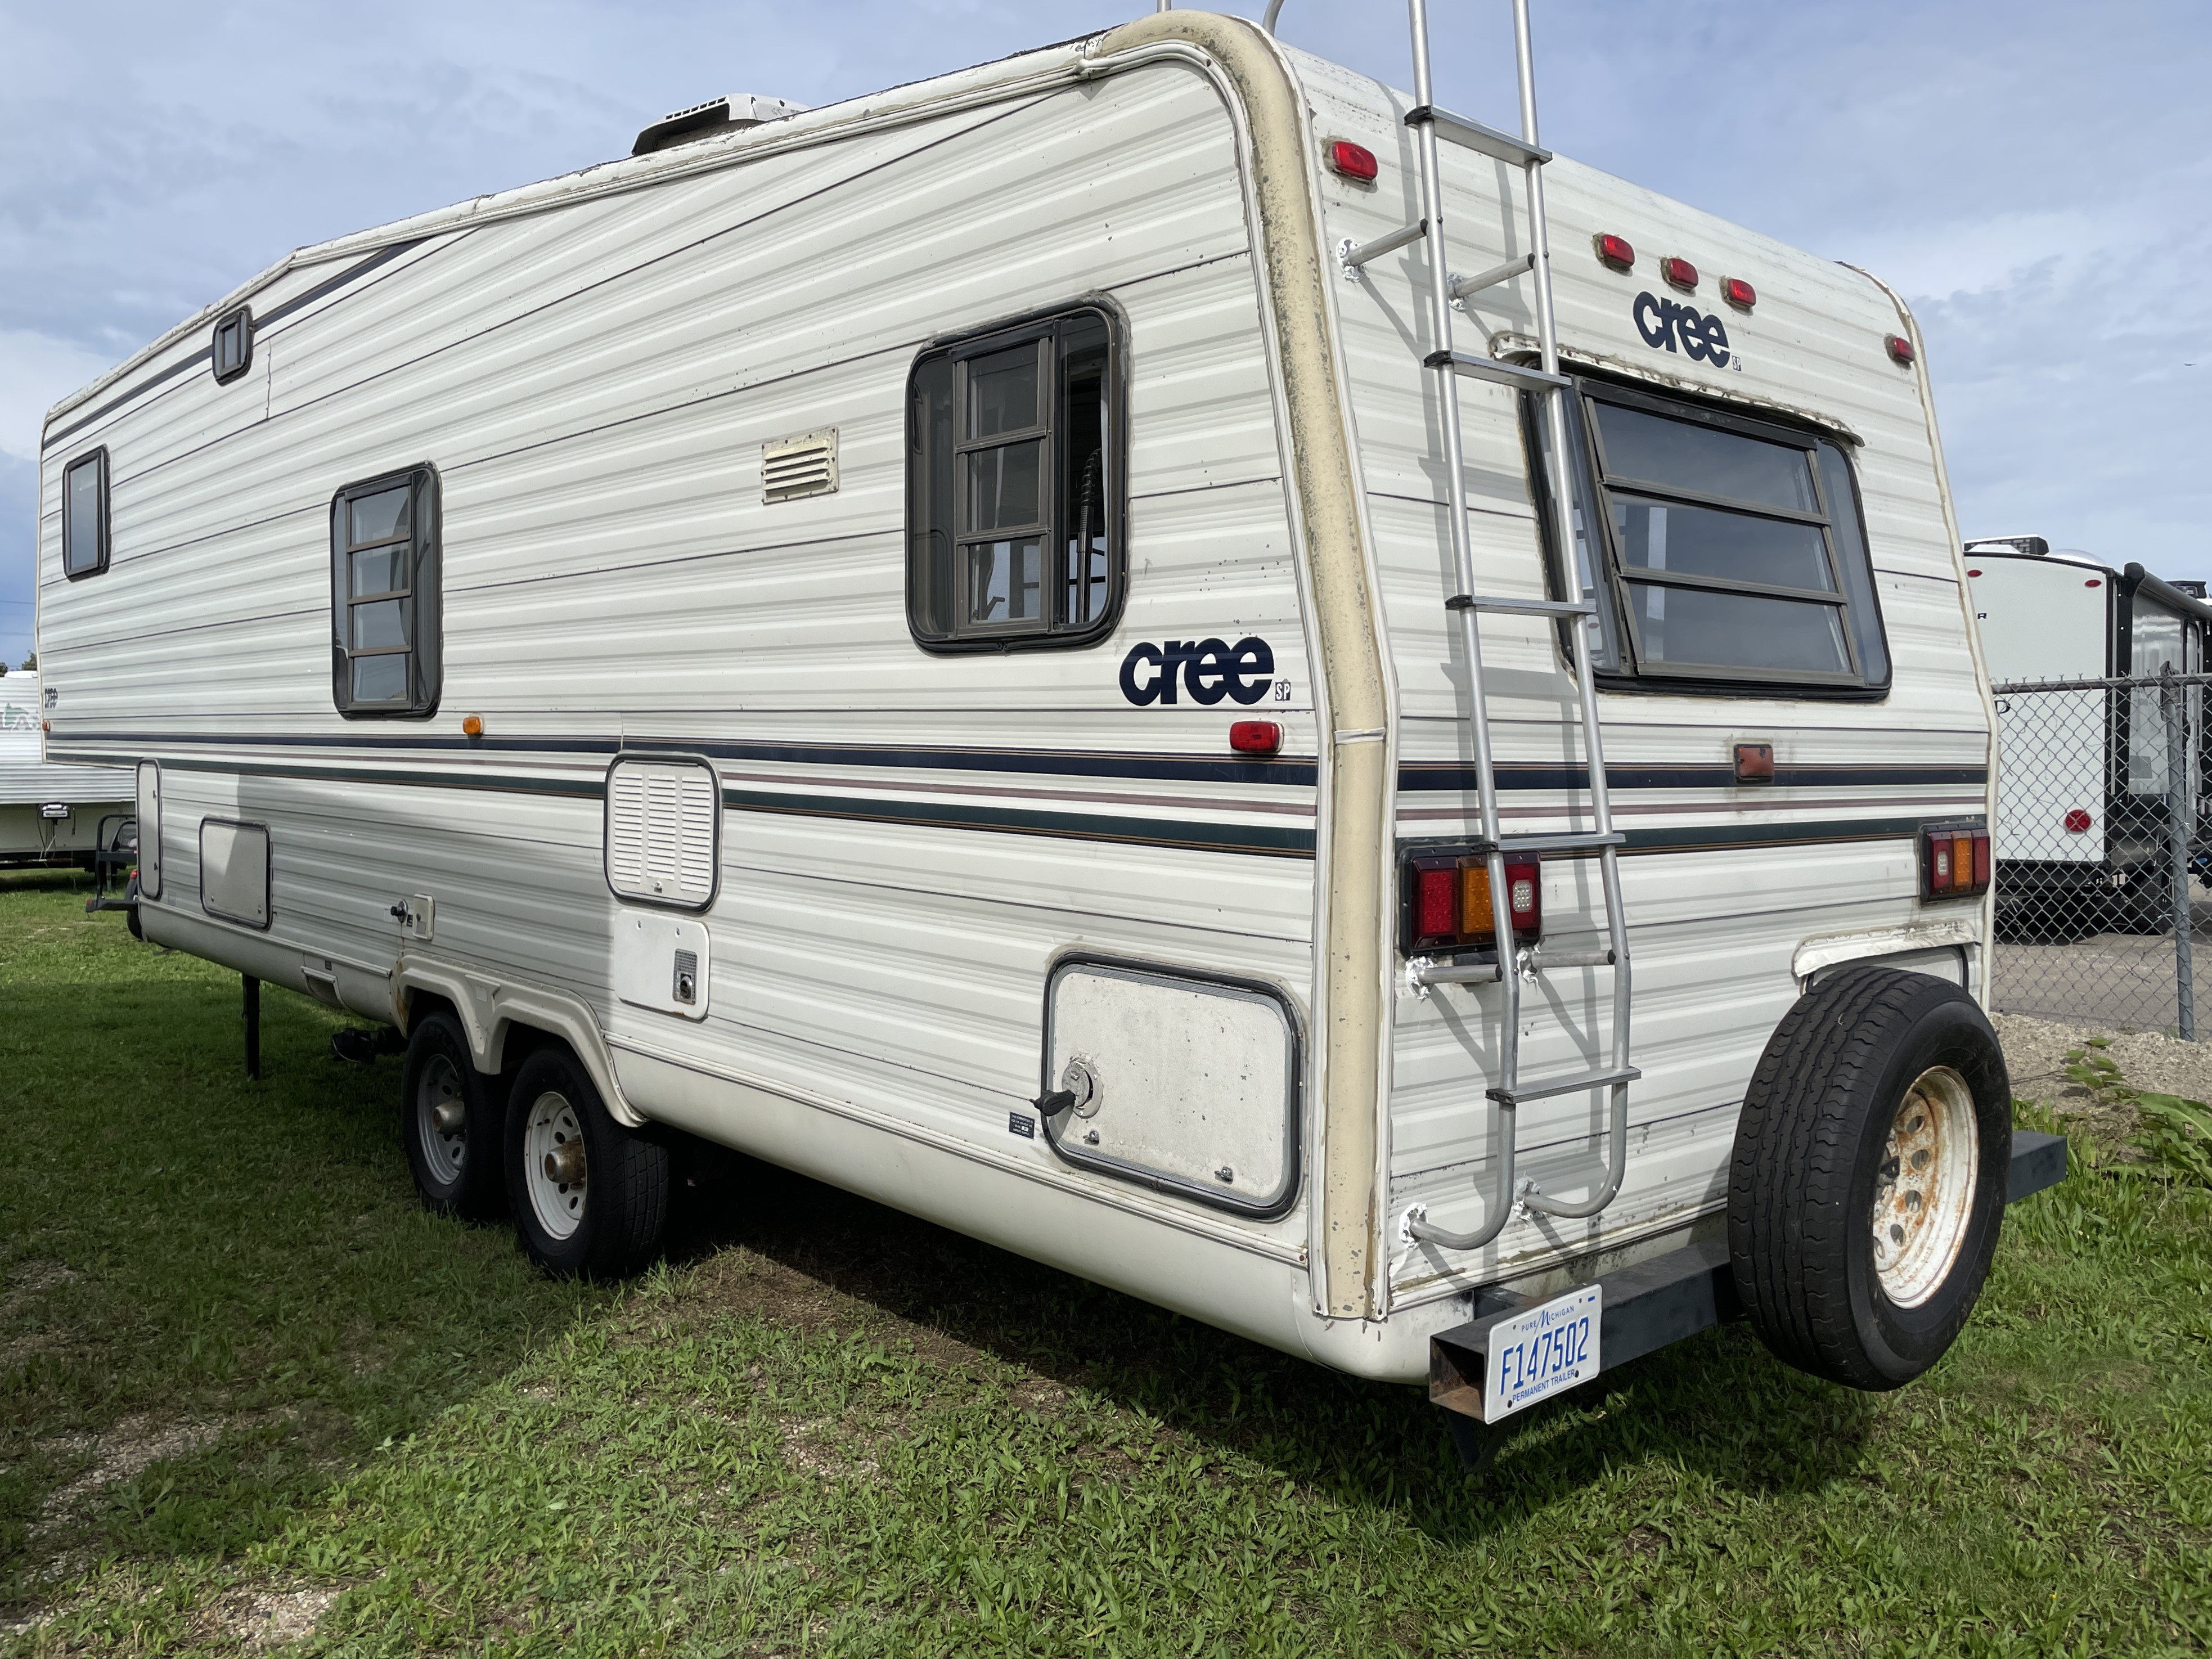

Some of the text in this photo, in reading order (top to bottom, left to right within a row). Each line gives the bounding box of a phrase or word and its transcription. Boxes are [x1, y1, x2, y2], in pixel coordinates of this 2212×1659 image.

[1633, 291, 1730, 368] cree
[1732, 356, 1741, 371] SP
[1119, 636, 1274, 706] cree
[1275, 682, 1291, 701] SP
[1521, 1321, 1536, 1332] PURE
[1500, 1316, 1589, 1396] F147502
[1512, 1369, 1575, 1403] PERMANENT TRAILER
